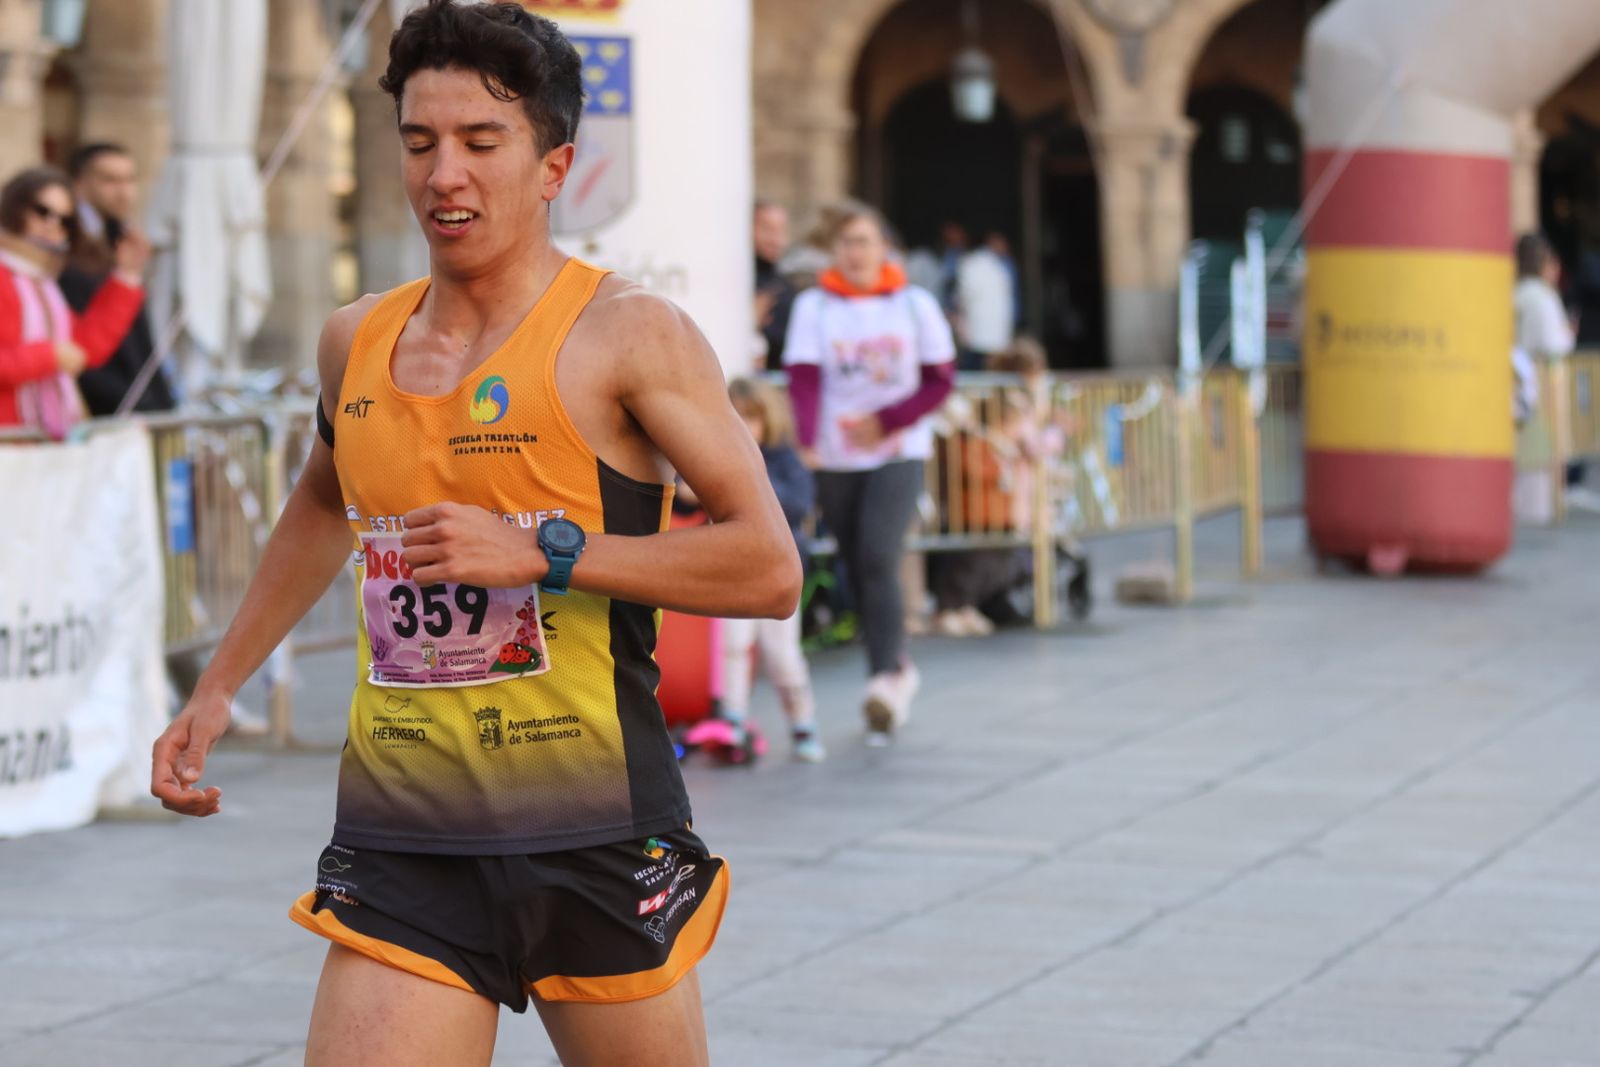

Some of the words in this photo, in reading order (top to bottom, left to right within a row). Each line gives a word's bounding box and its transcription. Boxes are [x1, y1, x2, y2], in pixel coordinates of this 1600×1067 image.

[449, 434, 482, 446] ESCUELA
[454, 446, 521, 456] SALMANTINA
[389, 583, 489, 639] 359
[438, 647, 486, 660] Ayuntamiento
[440, 659, 448, 668] de
[450, 656, 487, 667] Salamanca
[507, 713, 580, 732] Ayuntamiento
[372, 726, 426, 742] HERRERO
[509, 733, 522, 745] de
[524, 728, 582, 743] Salamanca
